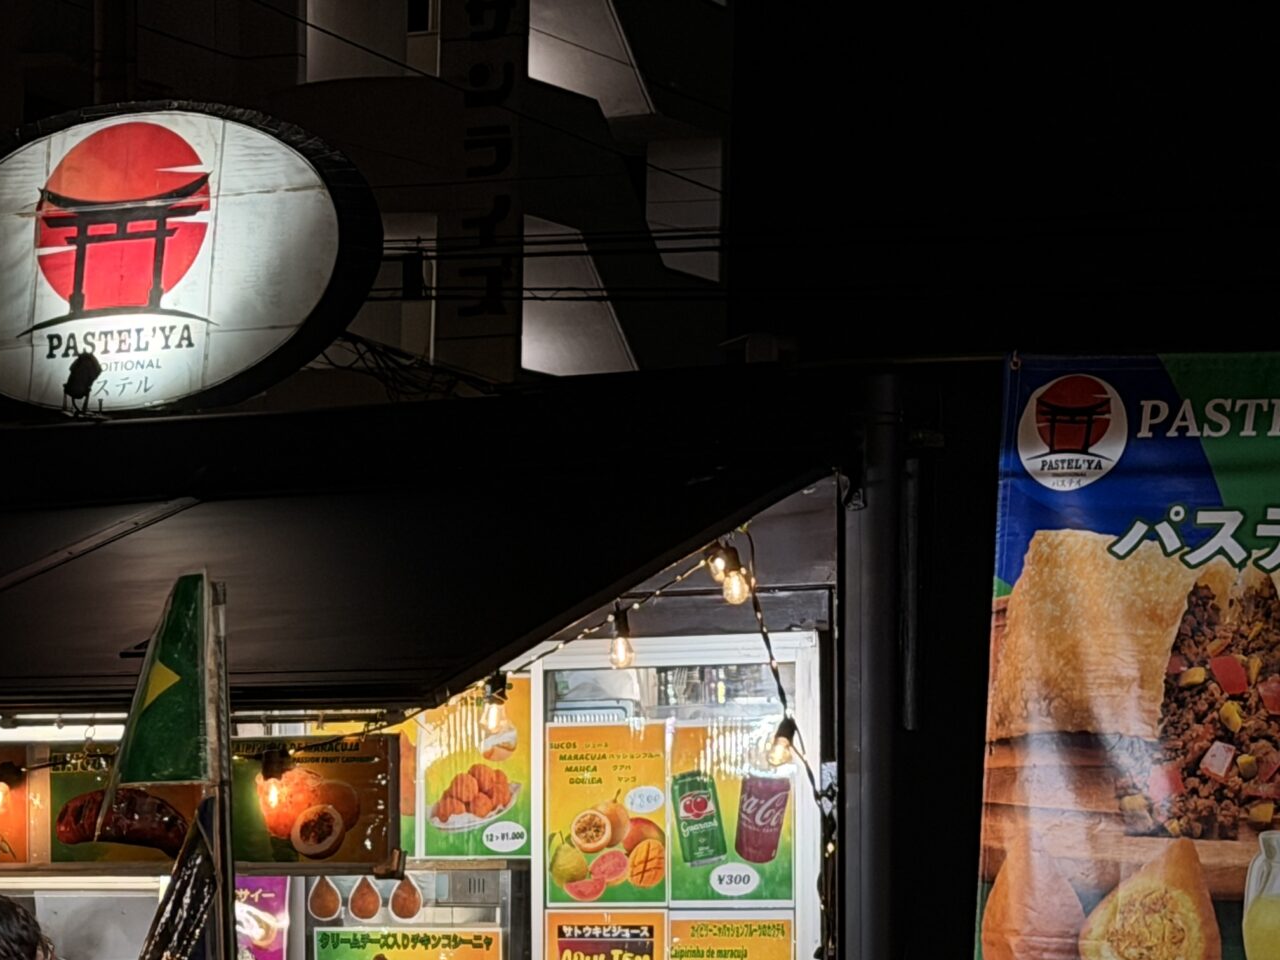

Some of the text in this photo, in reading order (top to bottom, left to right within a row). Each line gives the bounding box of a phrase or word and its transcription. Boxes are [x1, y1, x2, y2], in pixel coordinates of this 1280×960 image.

[46, 324, 195, 359] PASTEL'YA
[94, 376, 154, 396] ステル
[1040, 458, 1103, 471] PASTEL'YA
[559, 753, 607, 761] MARACUJA
[486, 834, 494, 842] 12
[717, 874, 751, 885] ¥300
[562, 925, 650, 938] サトウキビジュース
[706, 945, 716, 959] de
